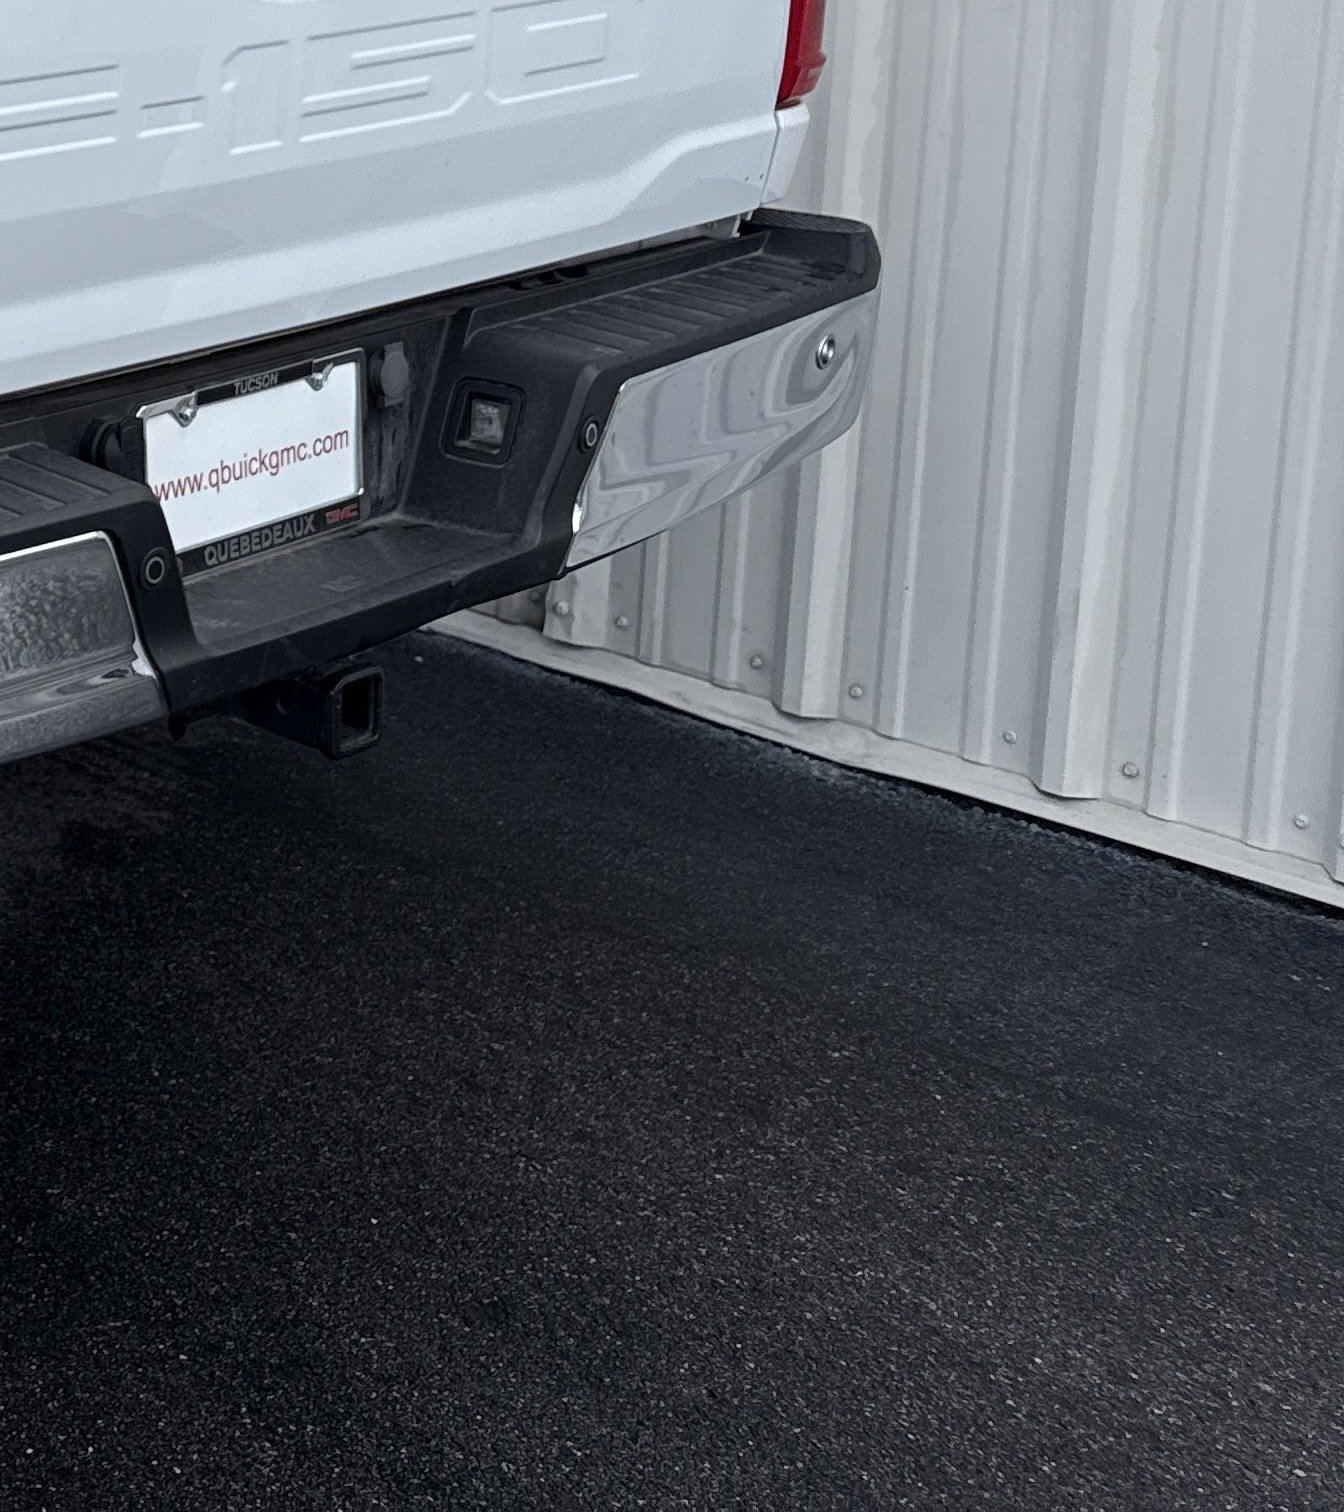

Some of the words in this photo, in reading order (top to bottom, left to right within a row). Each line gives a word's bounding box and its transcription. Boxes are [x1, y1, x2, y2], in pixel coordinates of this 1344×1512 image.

[235, 372, 278, 396] TUCSON
[152, 429, 349, 502] www.qbuickgmc.com
[204, 514, 315, 567] QUEBEDEAUX
[325, 503, 358, 524] GMC
